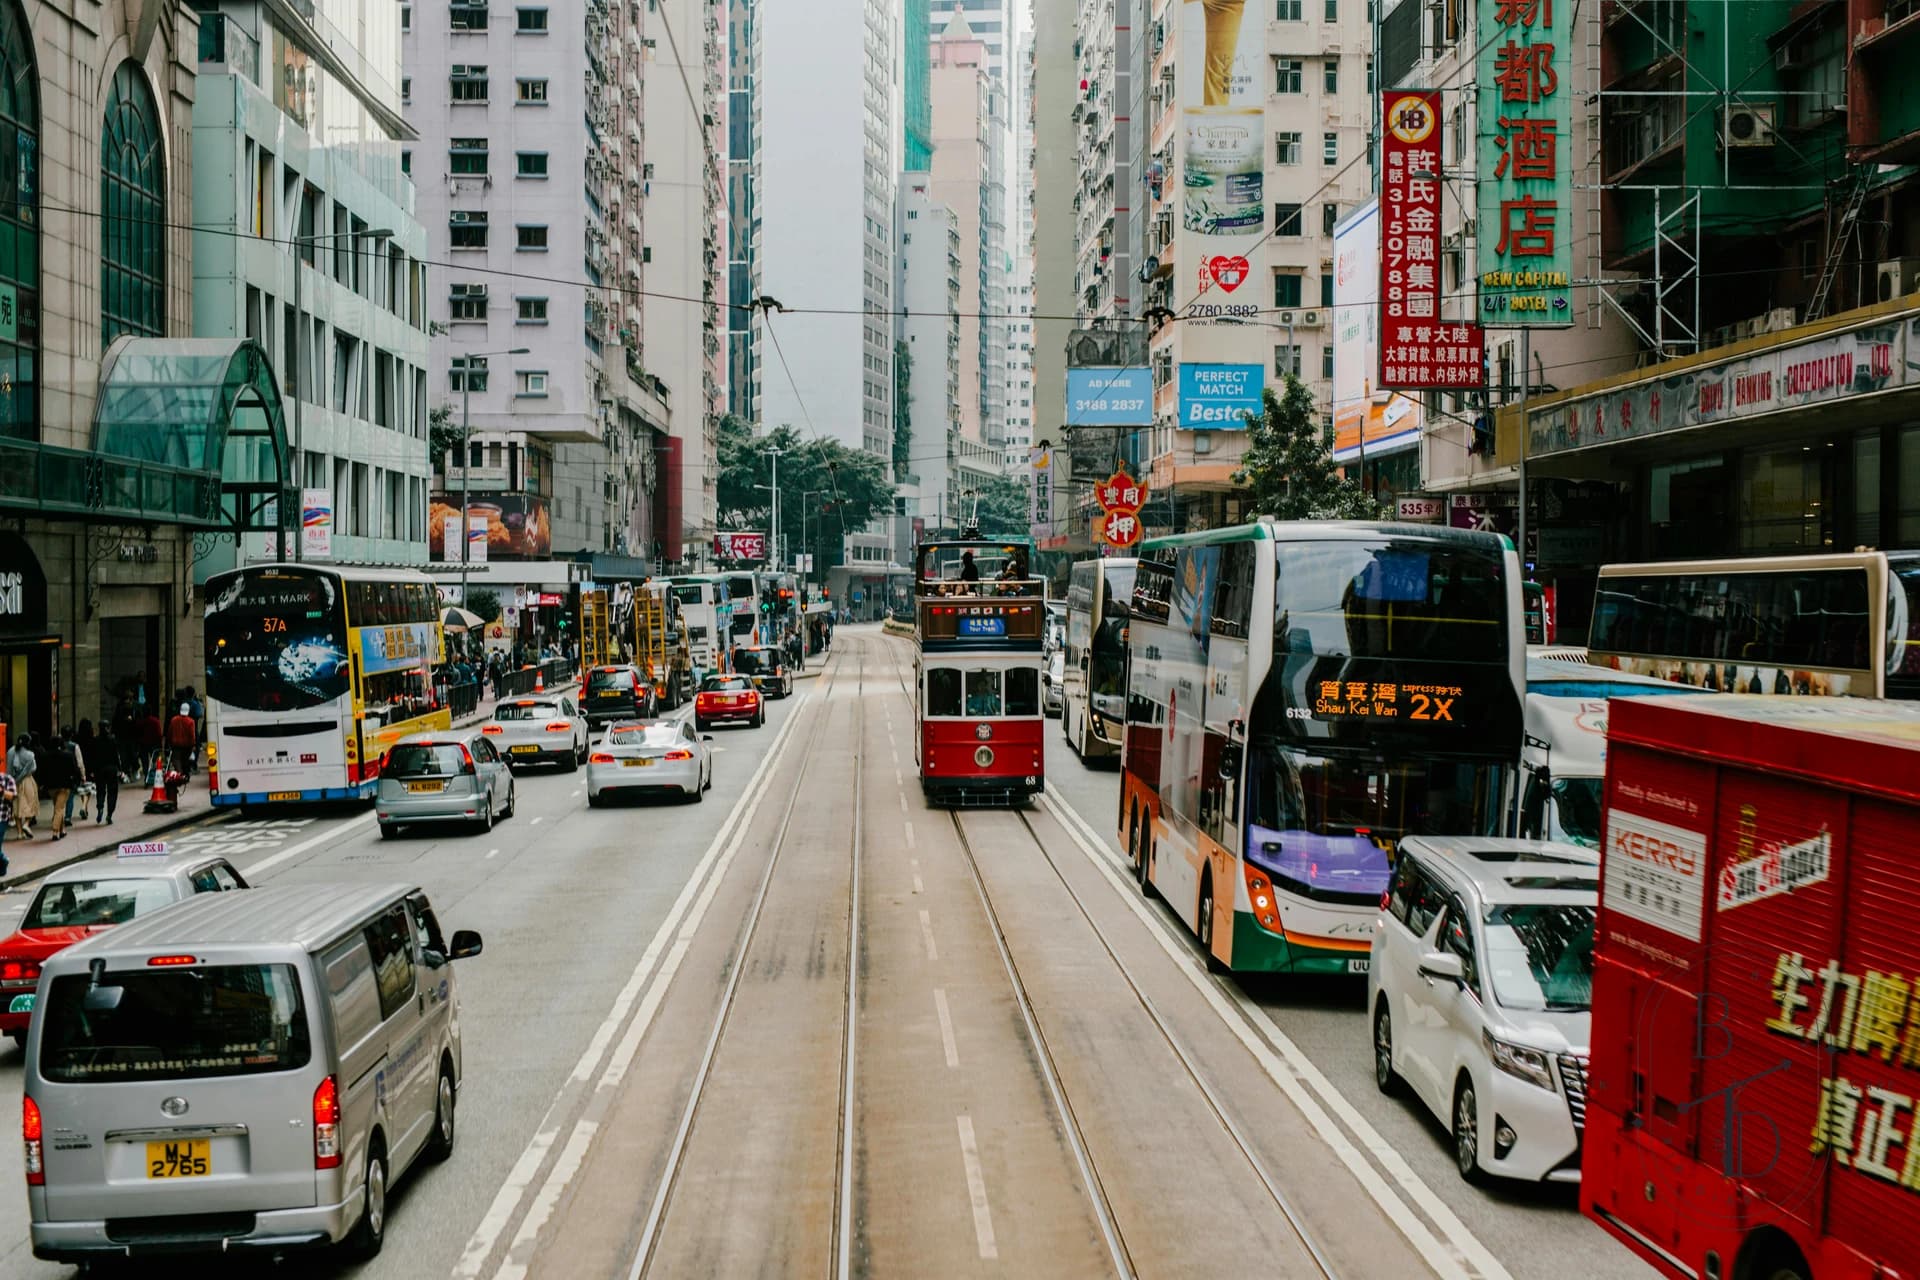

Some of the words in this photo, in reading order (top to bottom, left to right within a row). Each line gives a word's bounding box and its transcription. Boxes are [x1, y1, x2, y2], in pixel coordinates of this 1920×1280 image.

[1484, 272, 1512, 287] NEW
[1515, 271, 1569, 287] CAPITAL
[1510, 296, 1548, 311] HOTEL
[1189, 304, 1222, 318] 2780
[1225, 304, 1259, 318] 3882
[1088, 379, 1104, 388] AD
[1105, 379, 1132, 388] HERE
[1194, 371, 1249, 383] PERFECT
[1735, 370, 1772, 407] BANKING
[1787, 351, 1853, 396] CORPORATION
[1199, 384, 1244, 395] MATCH
[1075, 400, 1108, 411] 3188
[1111, 400, 1145, 411] 2837
[1106, 513, 1136, 542] 押
[733, 538, 761, 548] KFC
[270, 595, 277, 604] T
[279, 593, 312, 603] MARK
[263, 617, 287, 633] 37A
[1286, 707, 1313, 720] 6132
[1316, 699, 1346, 714] Shau
[1349, 701, 1370, 716] Kei
[1374, 702, 1398, 717] Wan
[1409, 694, 1454, 721] 2X
[1025, 775, 1036, 785] 68
[1687, 797, 1699, 818] by
[175, 828, 301, 843] BUS
[122, 842, 164, 855] TAXI
[169, 841, 282, 855] TOP
[1614, 828, 1697, 878] KERRY
[1353, 960, 1370, 972] UU
[165, 1143, 193, 1163] MJ
[152, 1158, 207, 1178] 2765
